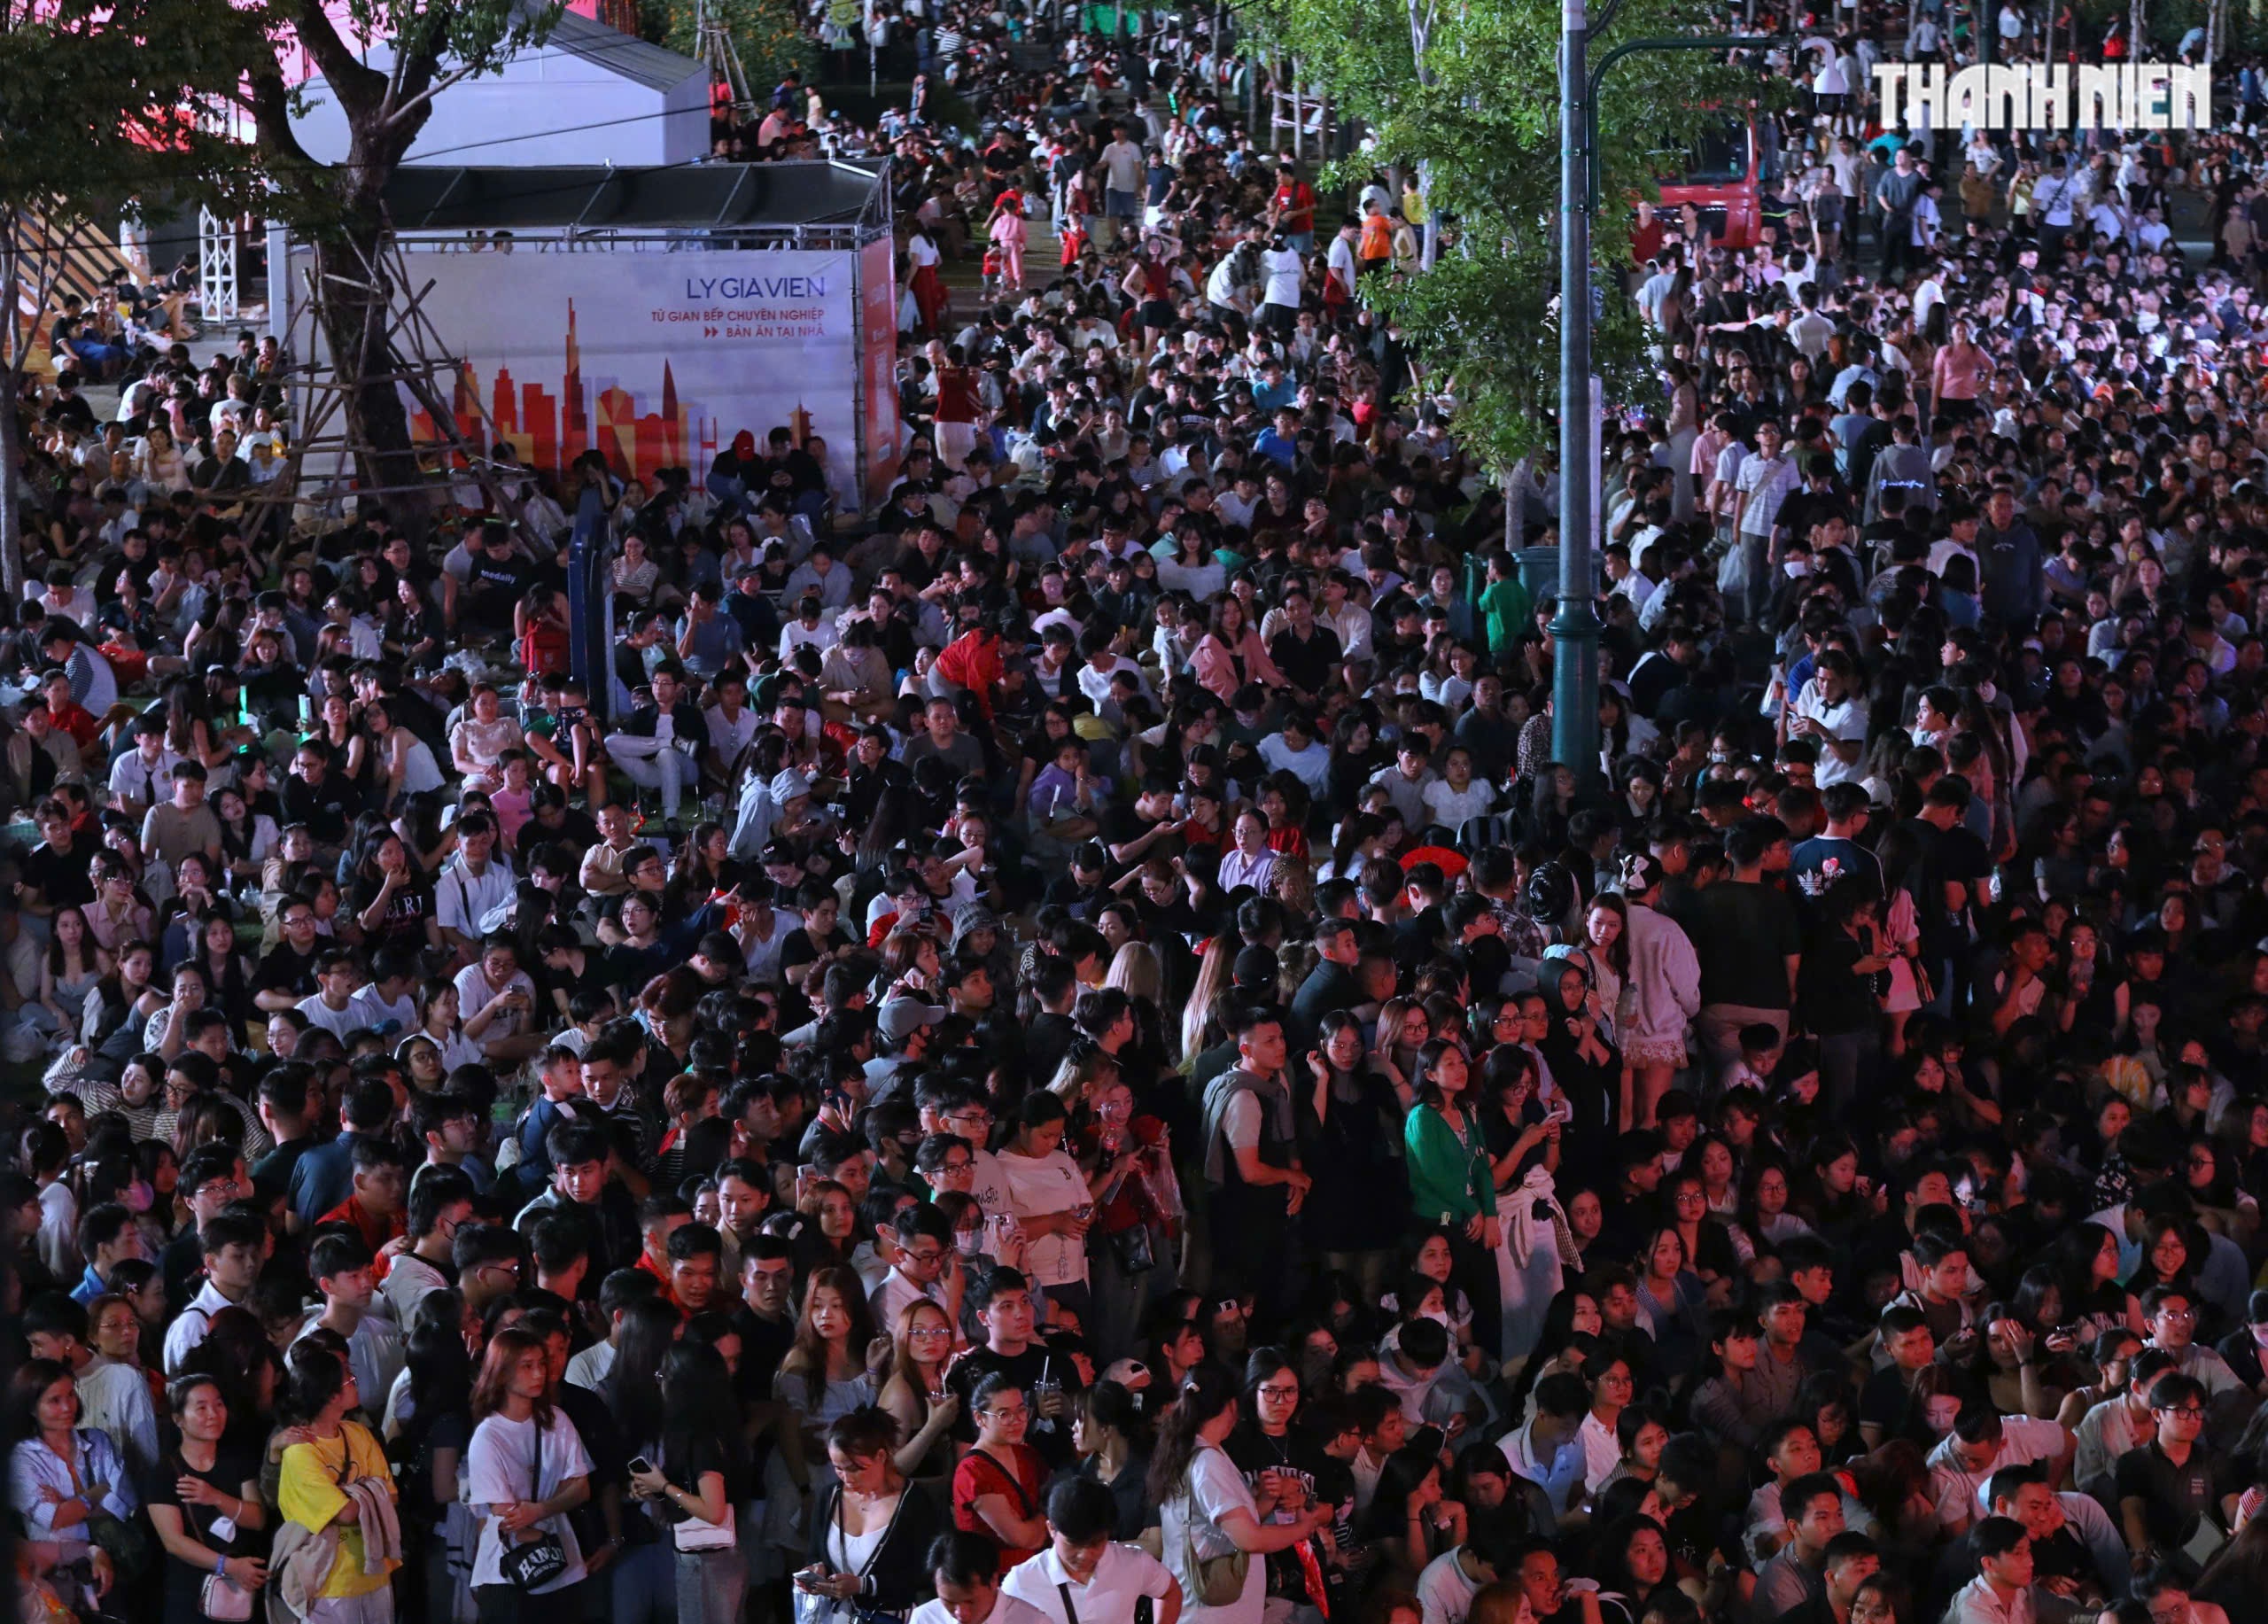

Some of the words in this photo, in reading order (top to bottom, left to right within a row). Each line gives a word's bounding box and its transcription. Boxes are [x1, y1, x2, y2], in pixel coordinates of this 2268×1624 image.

[667, 311, 700, 322] GIAN
[703, 307, 724, 321] BẾP
[726, 307, 776, 321] CHUYÊN
